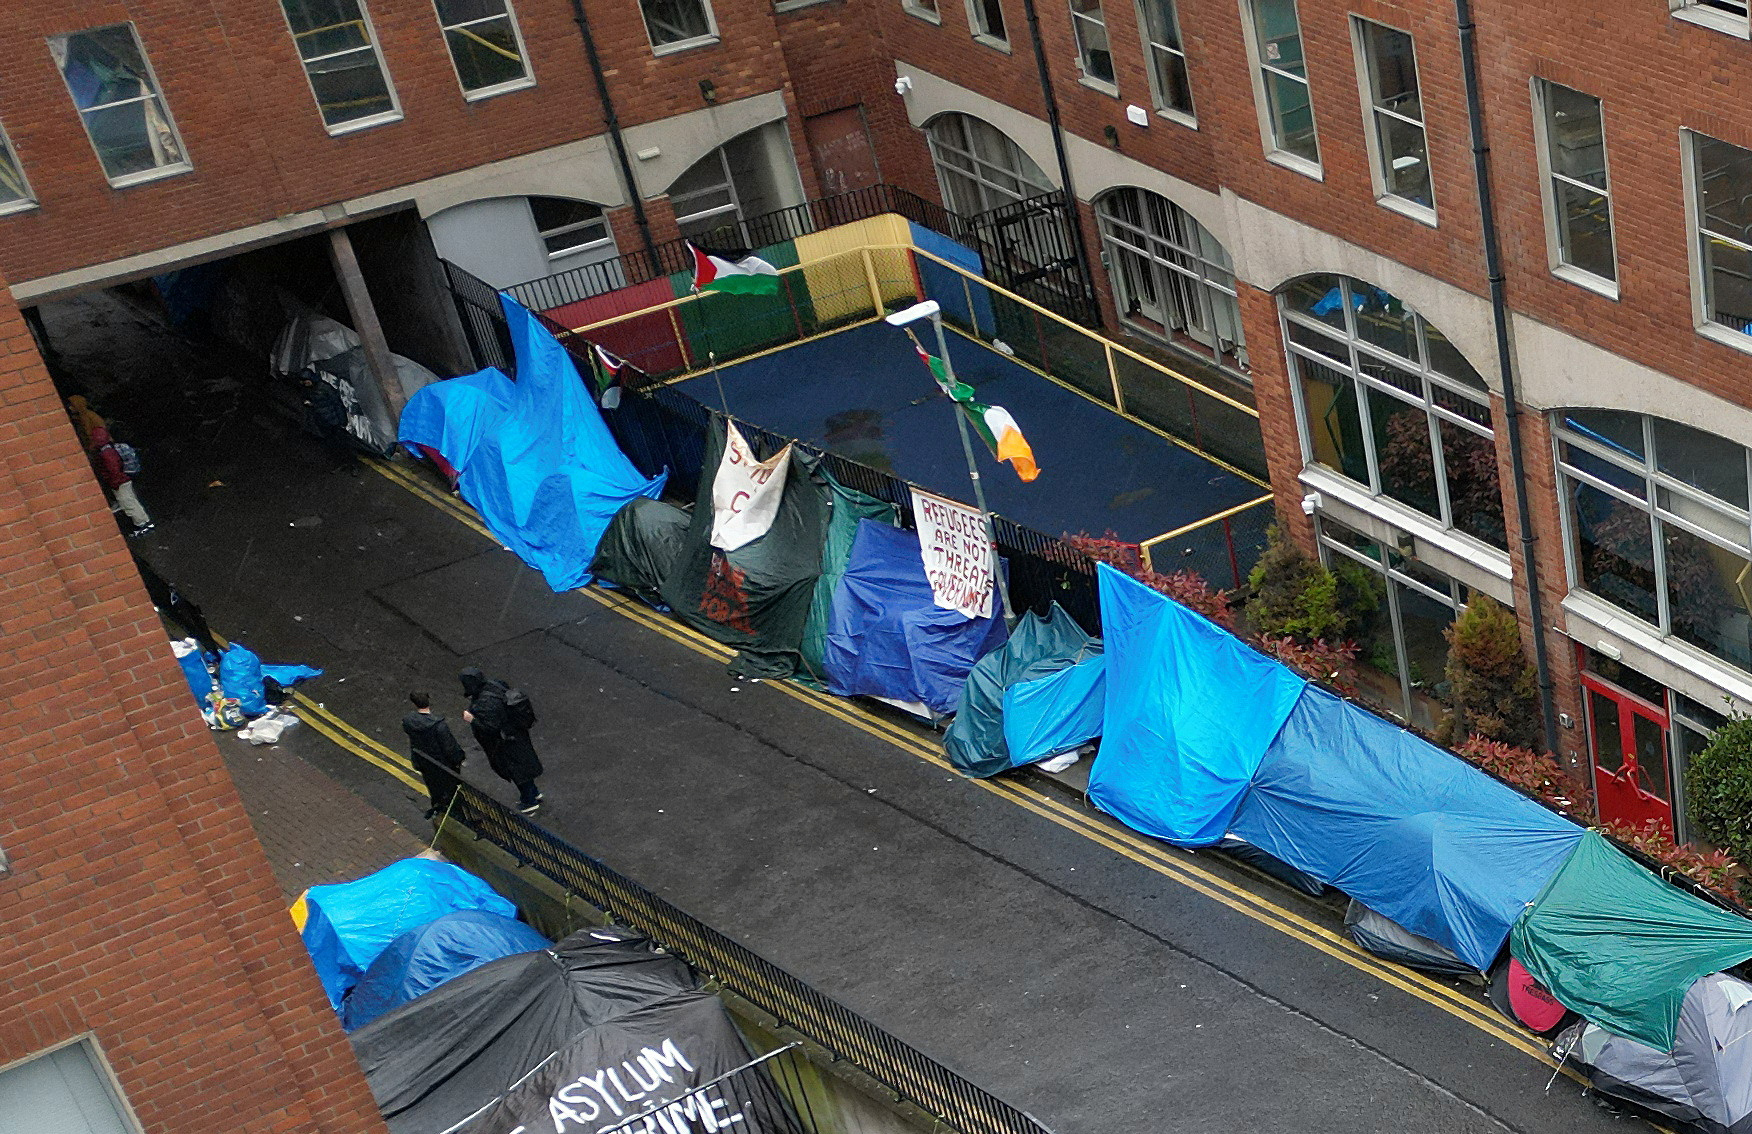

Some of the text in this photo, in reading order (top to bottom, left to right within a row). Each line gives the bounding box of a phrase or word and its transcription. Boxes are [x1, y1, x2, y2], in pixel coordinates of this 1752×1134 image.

[921, 499, 988, 545] REFUGEES
[935, 528, 987, 566] ARE NOT
[549, 1041, 694, 1134] ASYLUM
